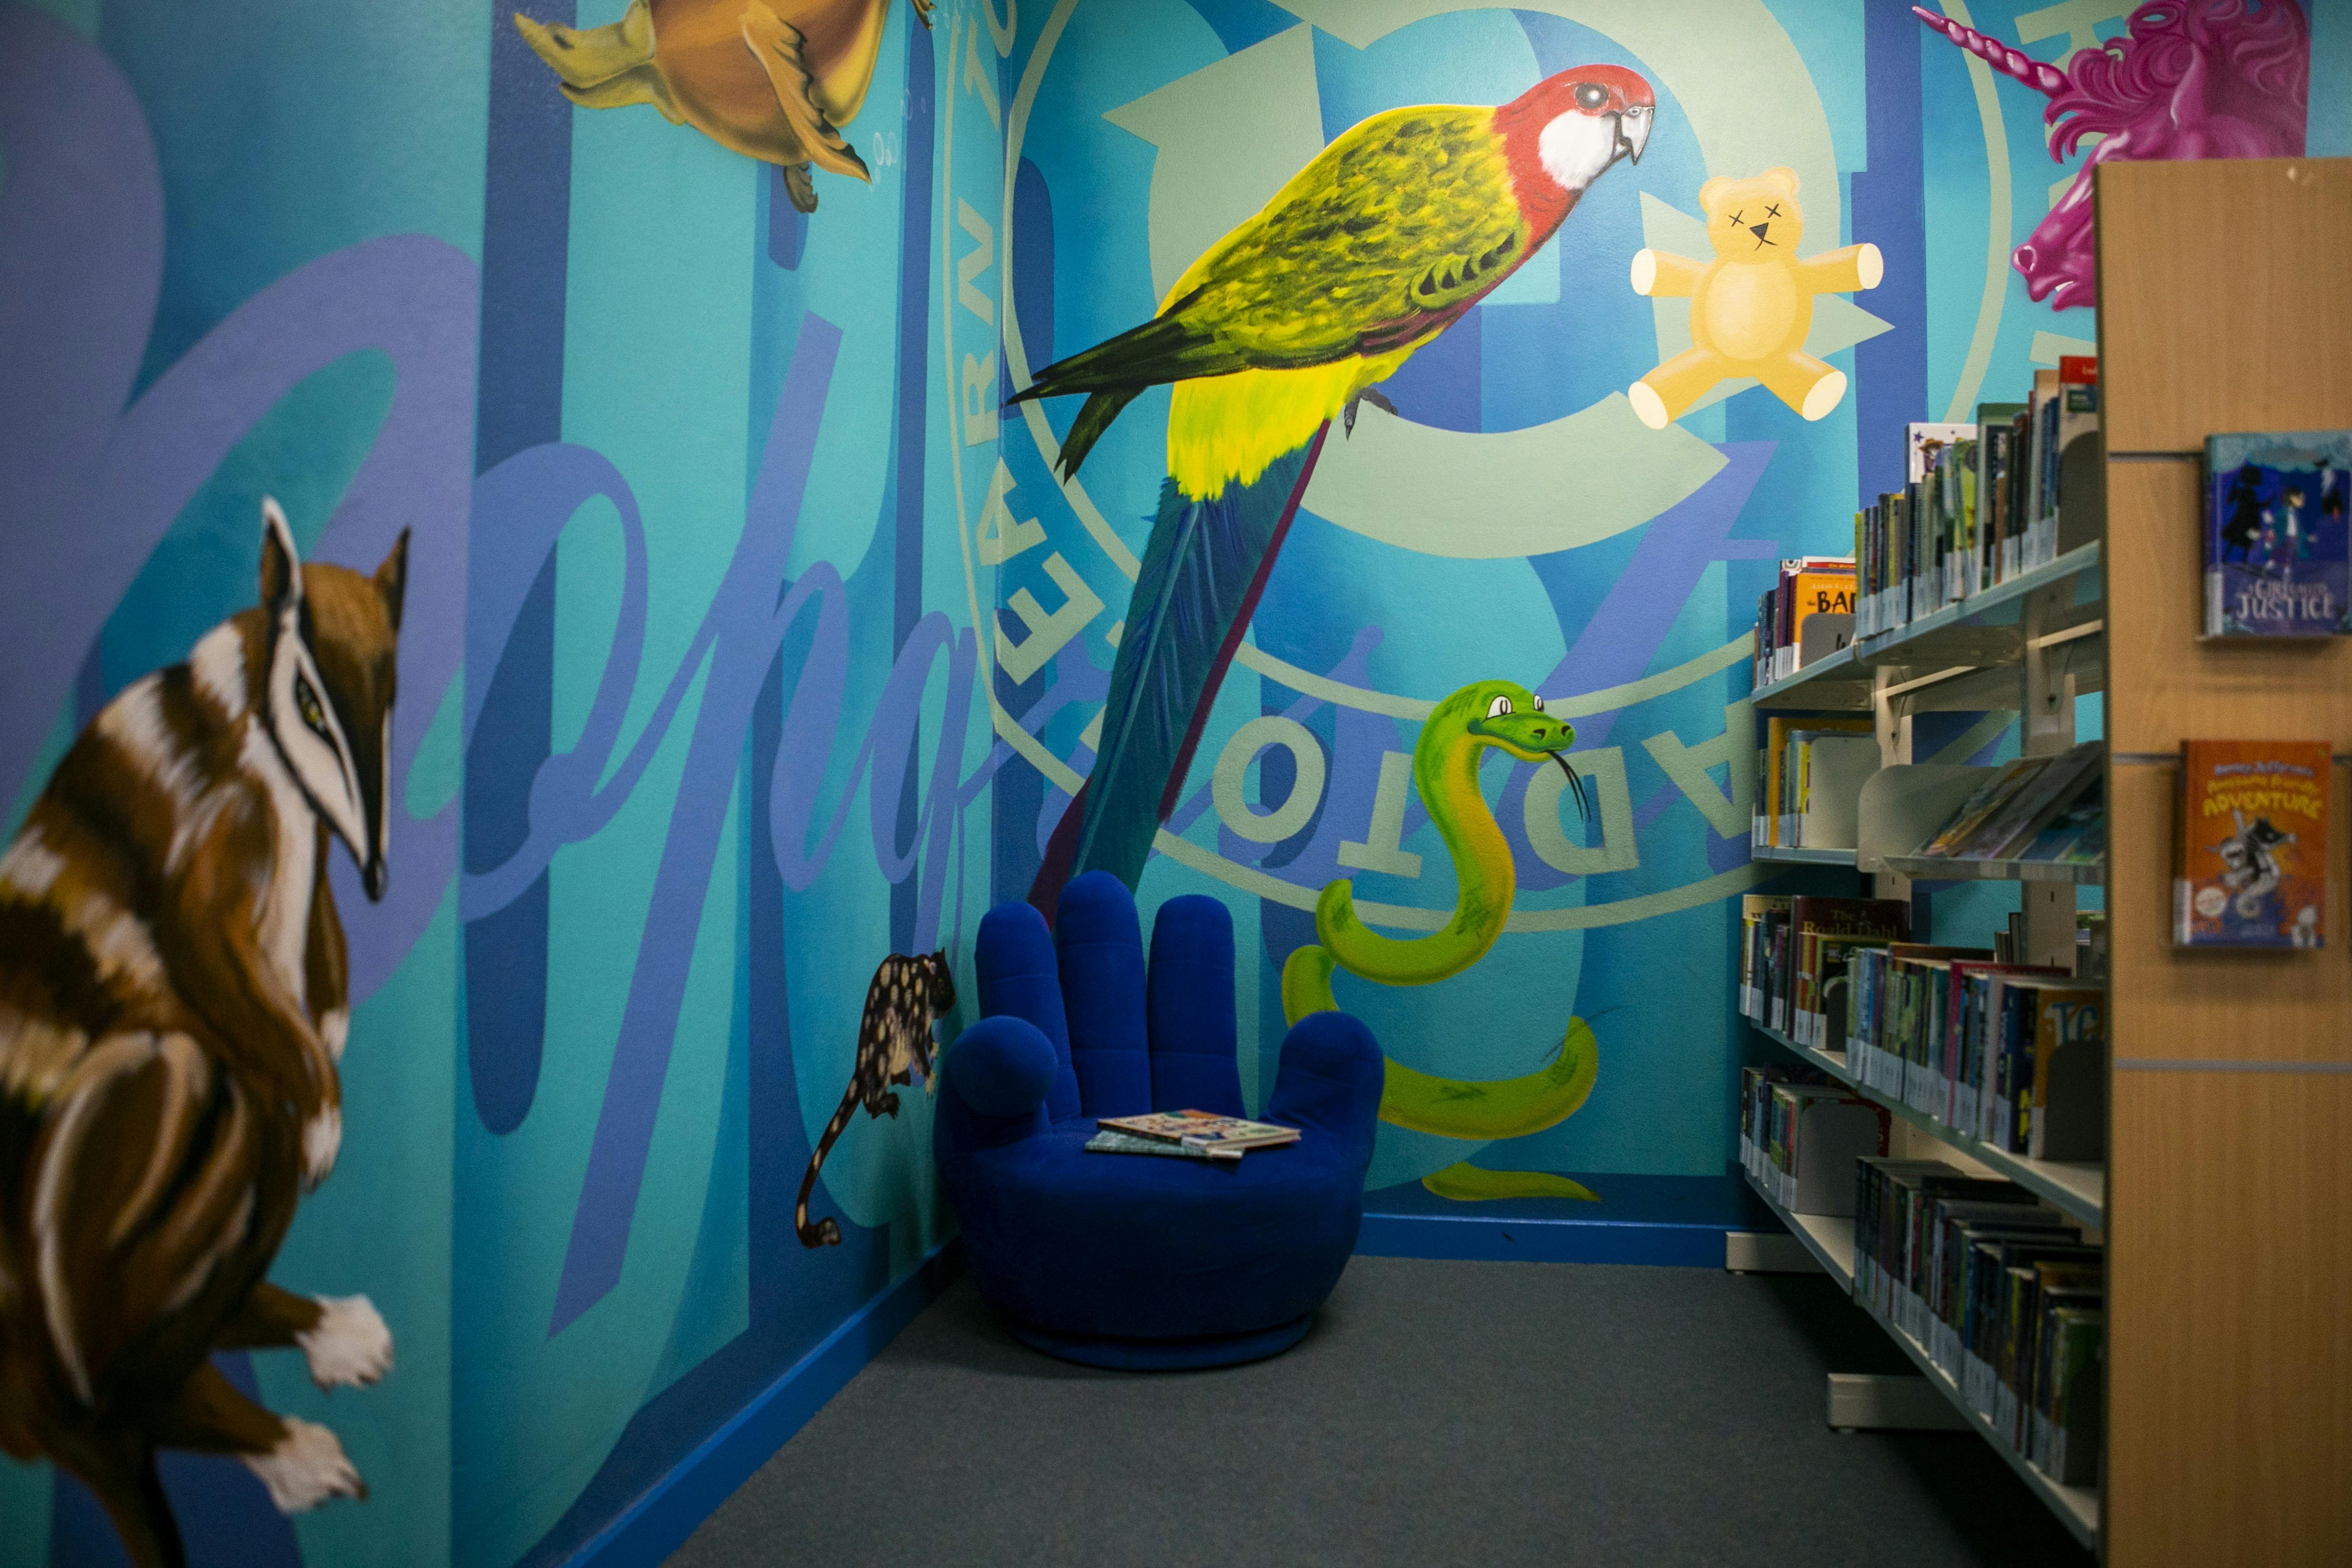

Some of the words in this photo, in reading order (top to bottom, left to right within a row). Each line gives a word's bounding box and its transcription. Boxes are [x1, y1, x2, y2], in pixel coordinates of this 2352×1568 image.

[956, 197, 1124, 753] EARN
[2235, 591, 2335, 620] JUSTICE
[1212, 715, 1423, 878] TO
[1803, 921, 1851, 935] Roald
[1857, 924, 1899, 939] Dahl
[1830, 910, 1855, 921] The
